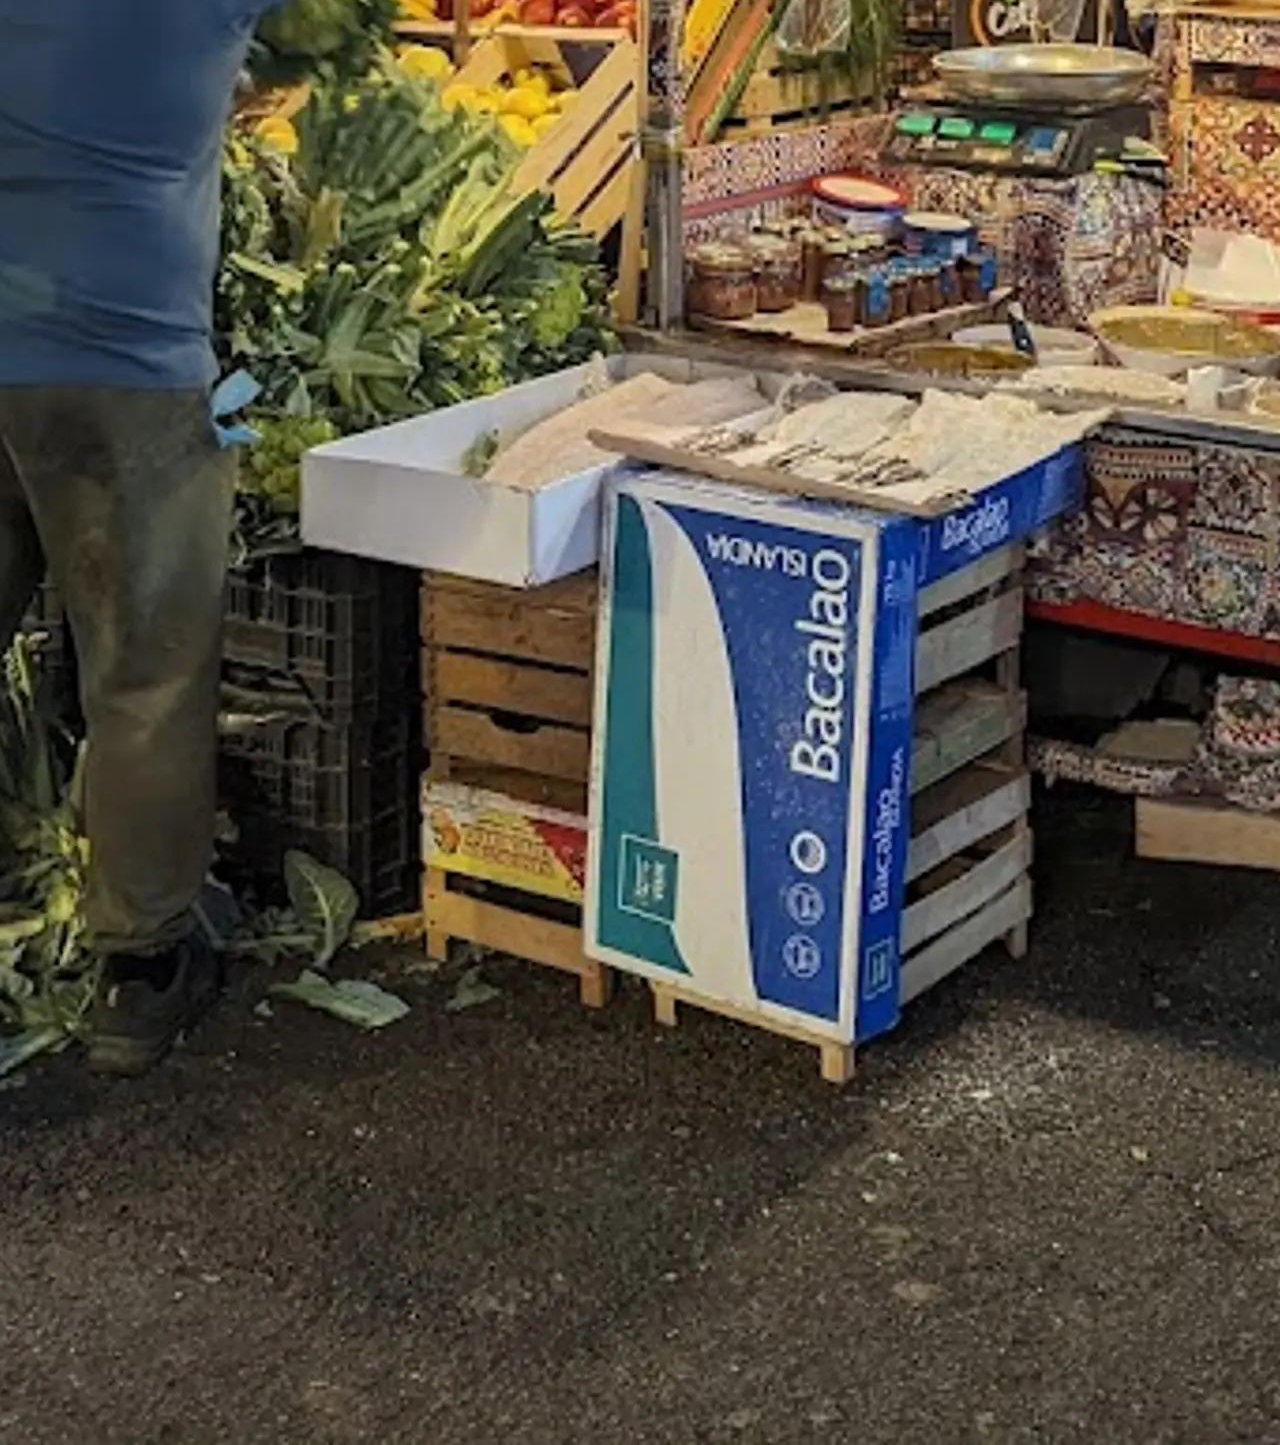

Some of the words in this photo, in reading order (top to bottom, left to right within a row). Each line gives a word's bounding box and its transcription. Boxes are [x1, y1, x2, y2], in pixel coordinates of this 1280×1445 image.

[704, 531, 807, 578] ISLANDIA
[788, 548, 852, 784] Bacalao
[868, 787, 894, 915] Bacalao
